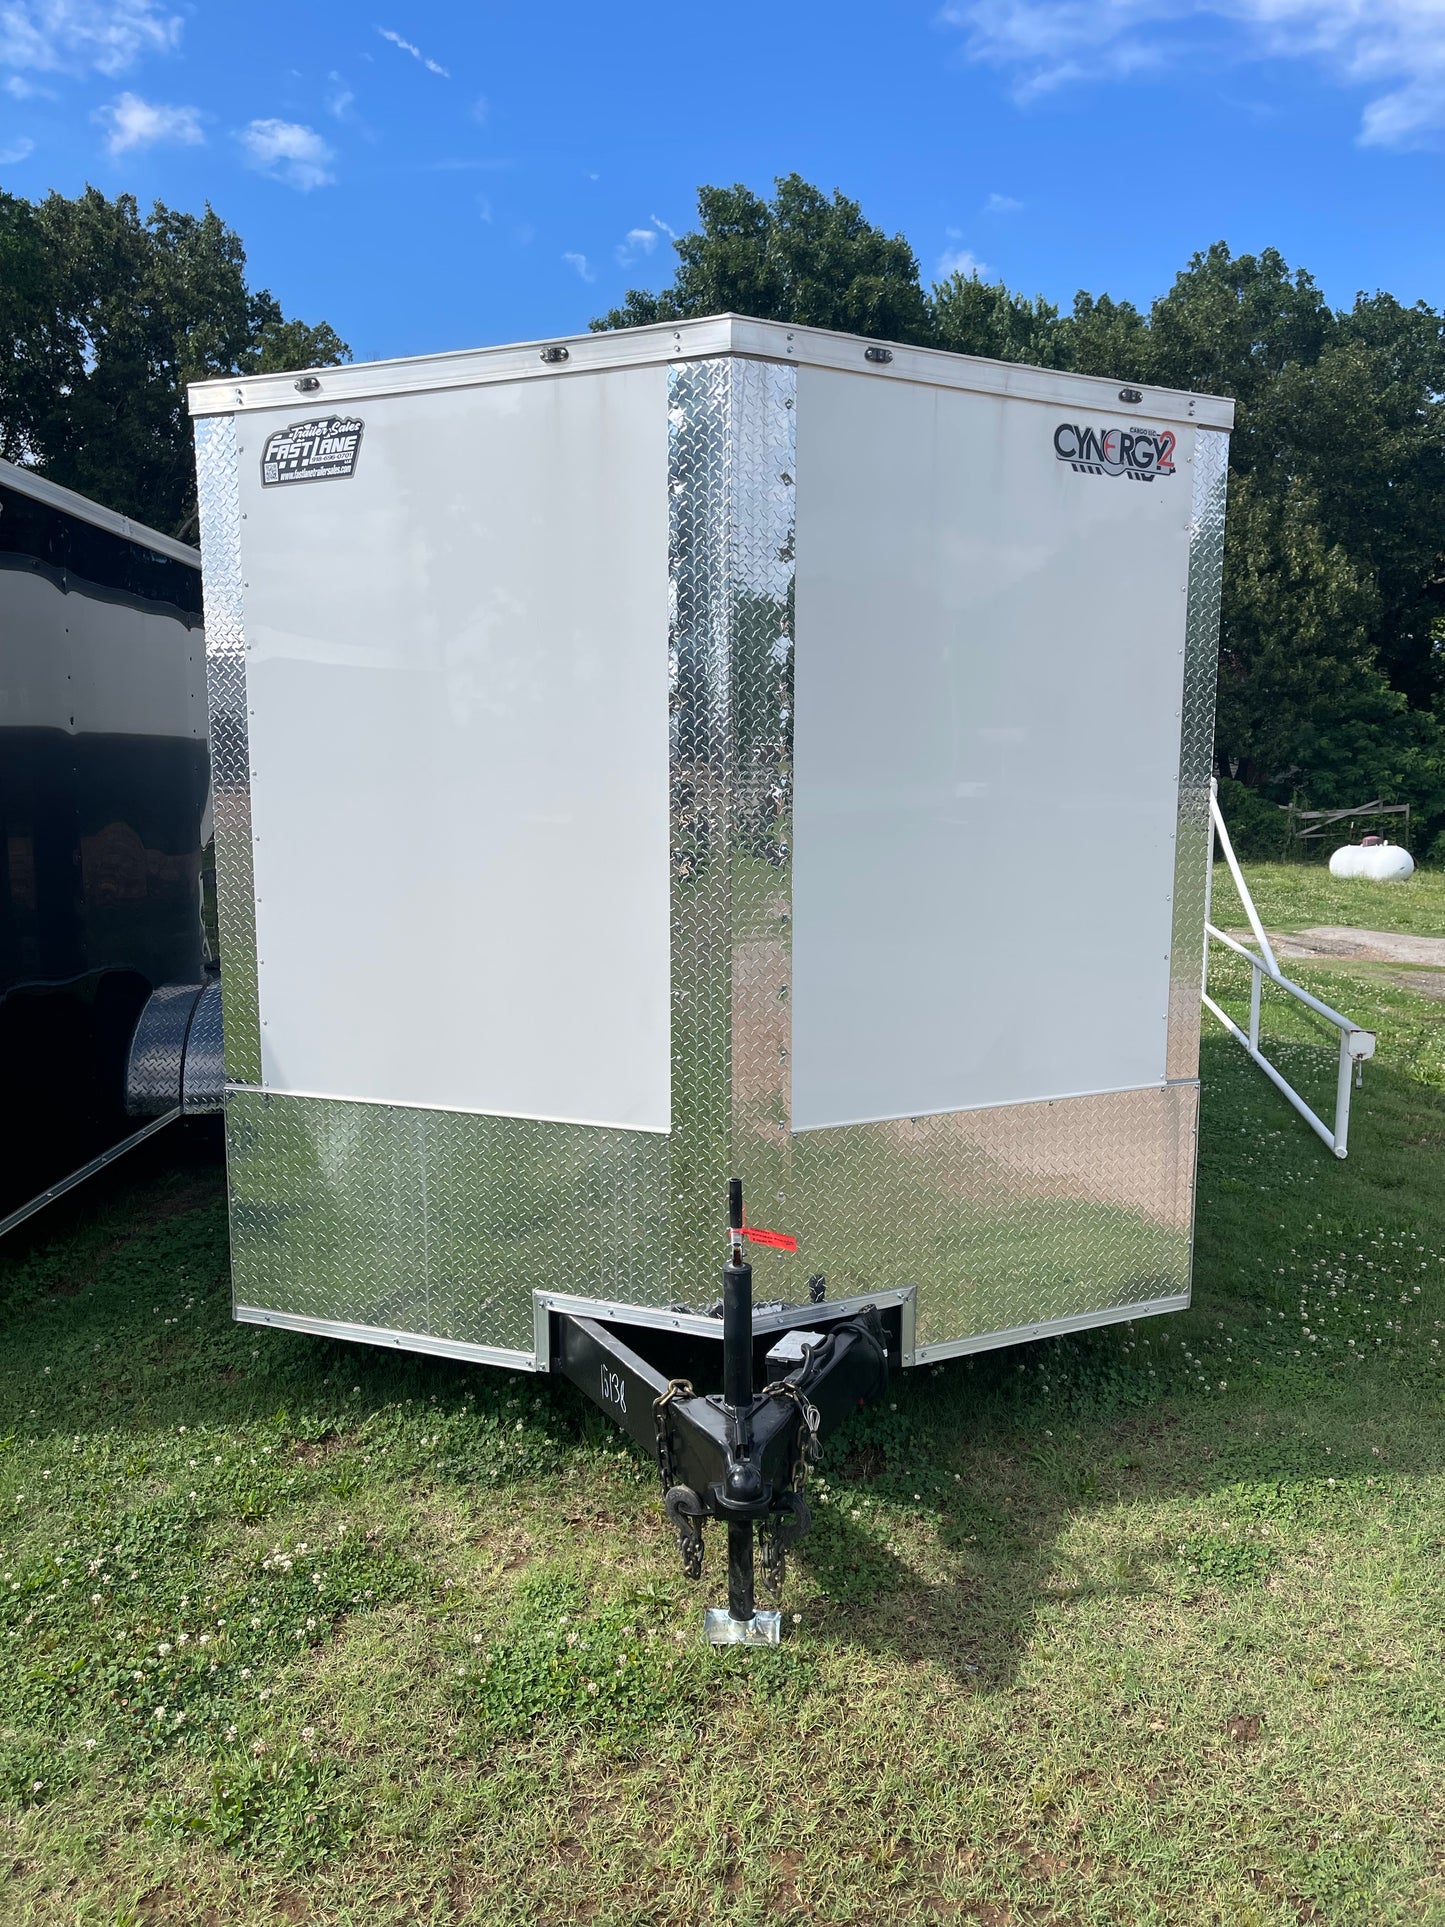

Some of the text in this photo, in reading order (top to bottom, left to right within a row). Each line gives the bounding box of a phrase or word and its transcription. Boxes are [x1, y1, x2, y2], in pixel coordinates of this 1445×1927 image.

[291, 421, 361, 440] Trailer Sales
[265, 435, 358, 462] FAST LANE
[280, 464, 352, 481] www.fastlanetrailersales.com
[600, 1363, 627, 1414] 15138
